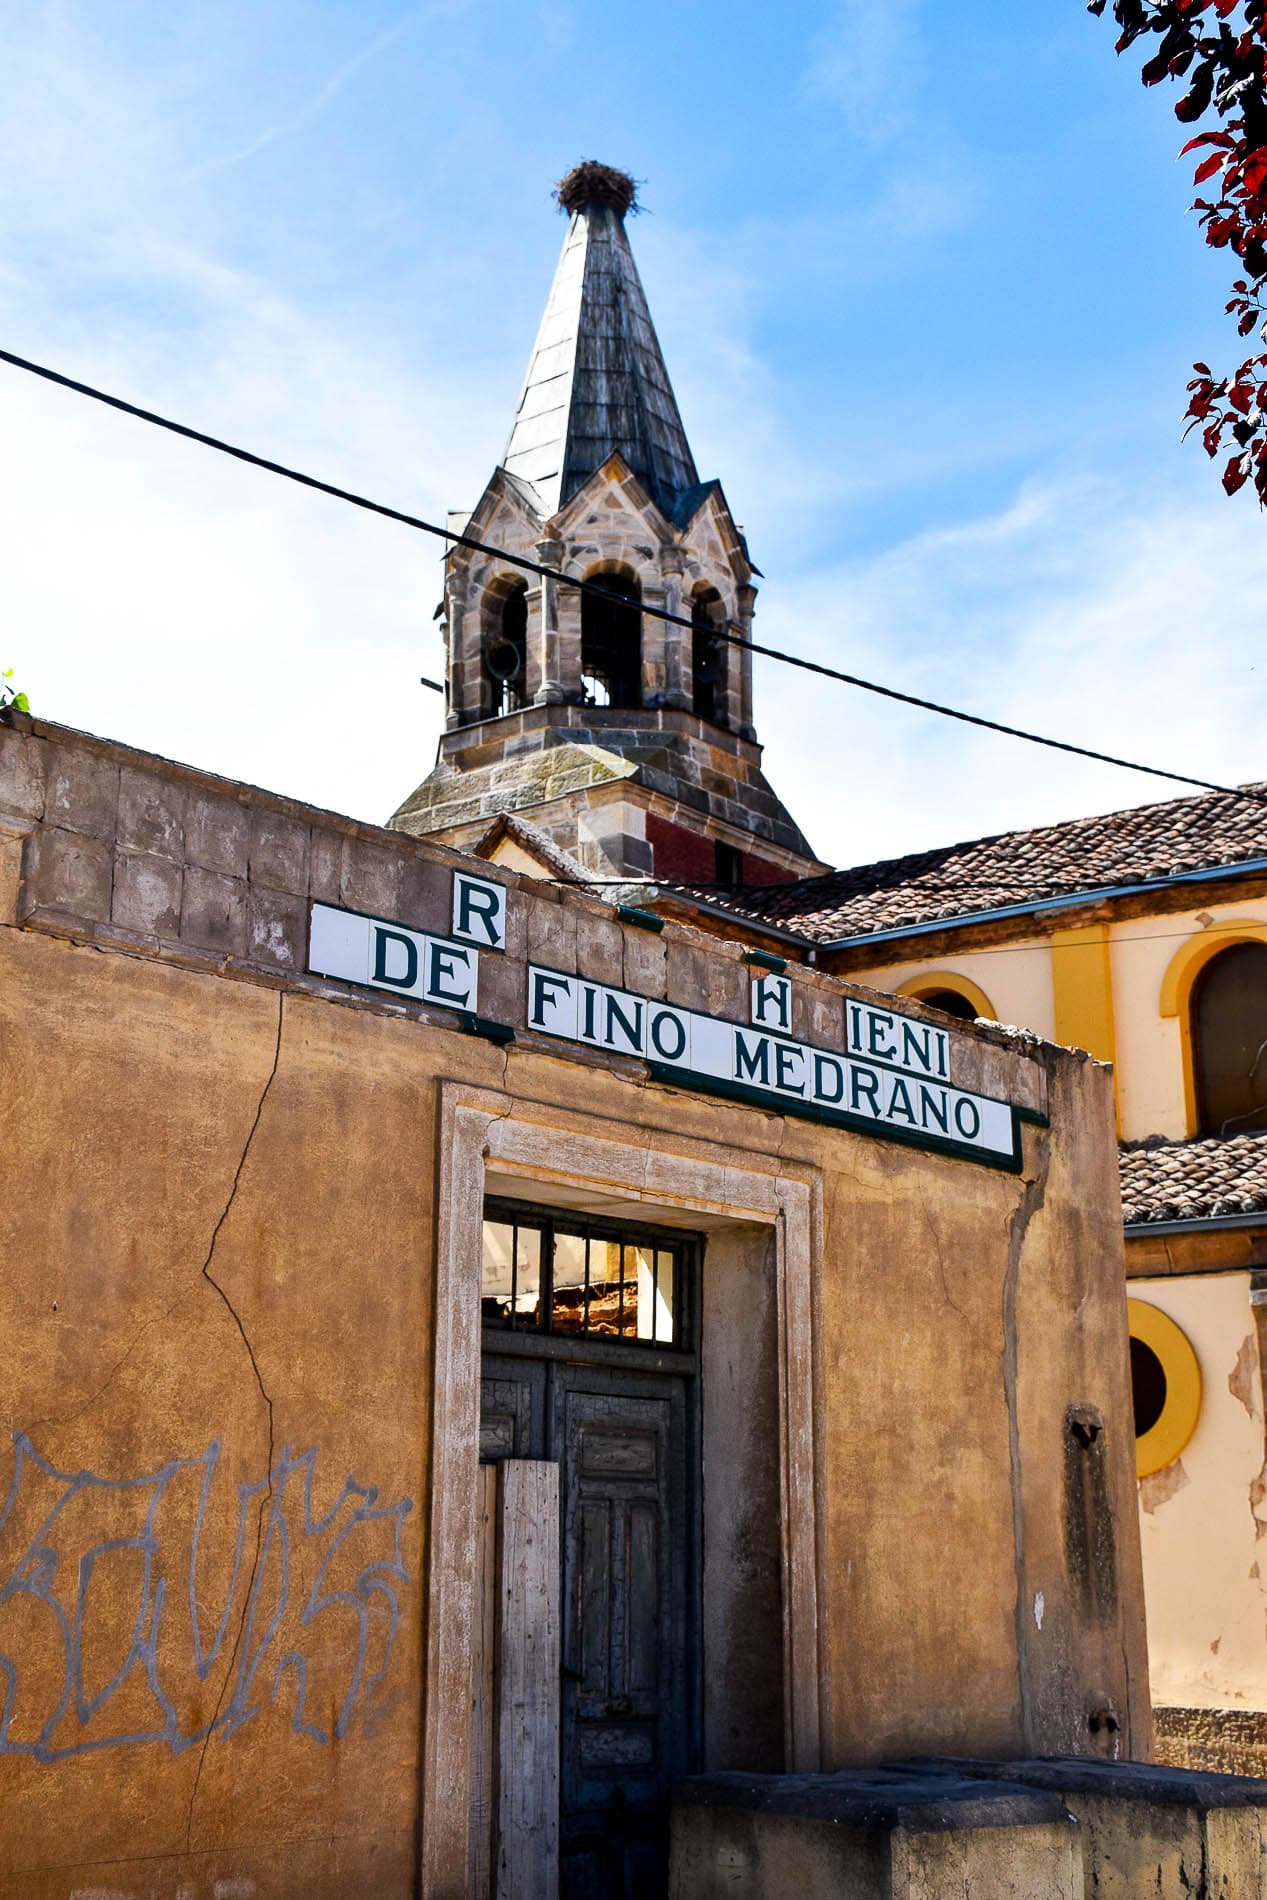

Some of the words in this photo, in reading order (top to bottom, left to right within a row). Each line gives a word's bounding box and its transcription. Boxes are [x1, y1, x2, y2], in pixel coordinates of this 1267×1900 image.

[372, 926, 471, 1009] DE
[530, 972, 686, 1062] FINO
[734, 1030, 980, 1140] MEDRANO
[457, 879, 501, 946] R
[755, 978, 789, 1028] H
[850, 1005, 949, 1077] IENI
